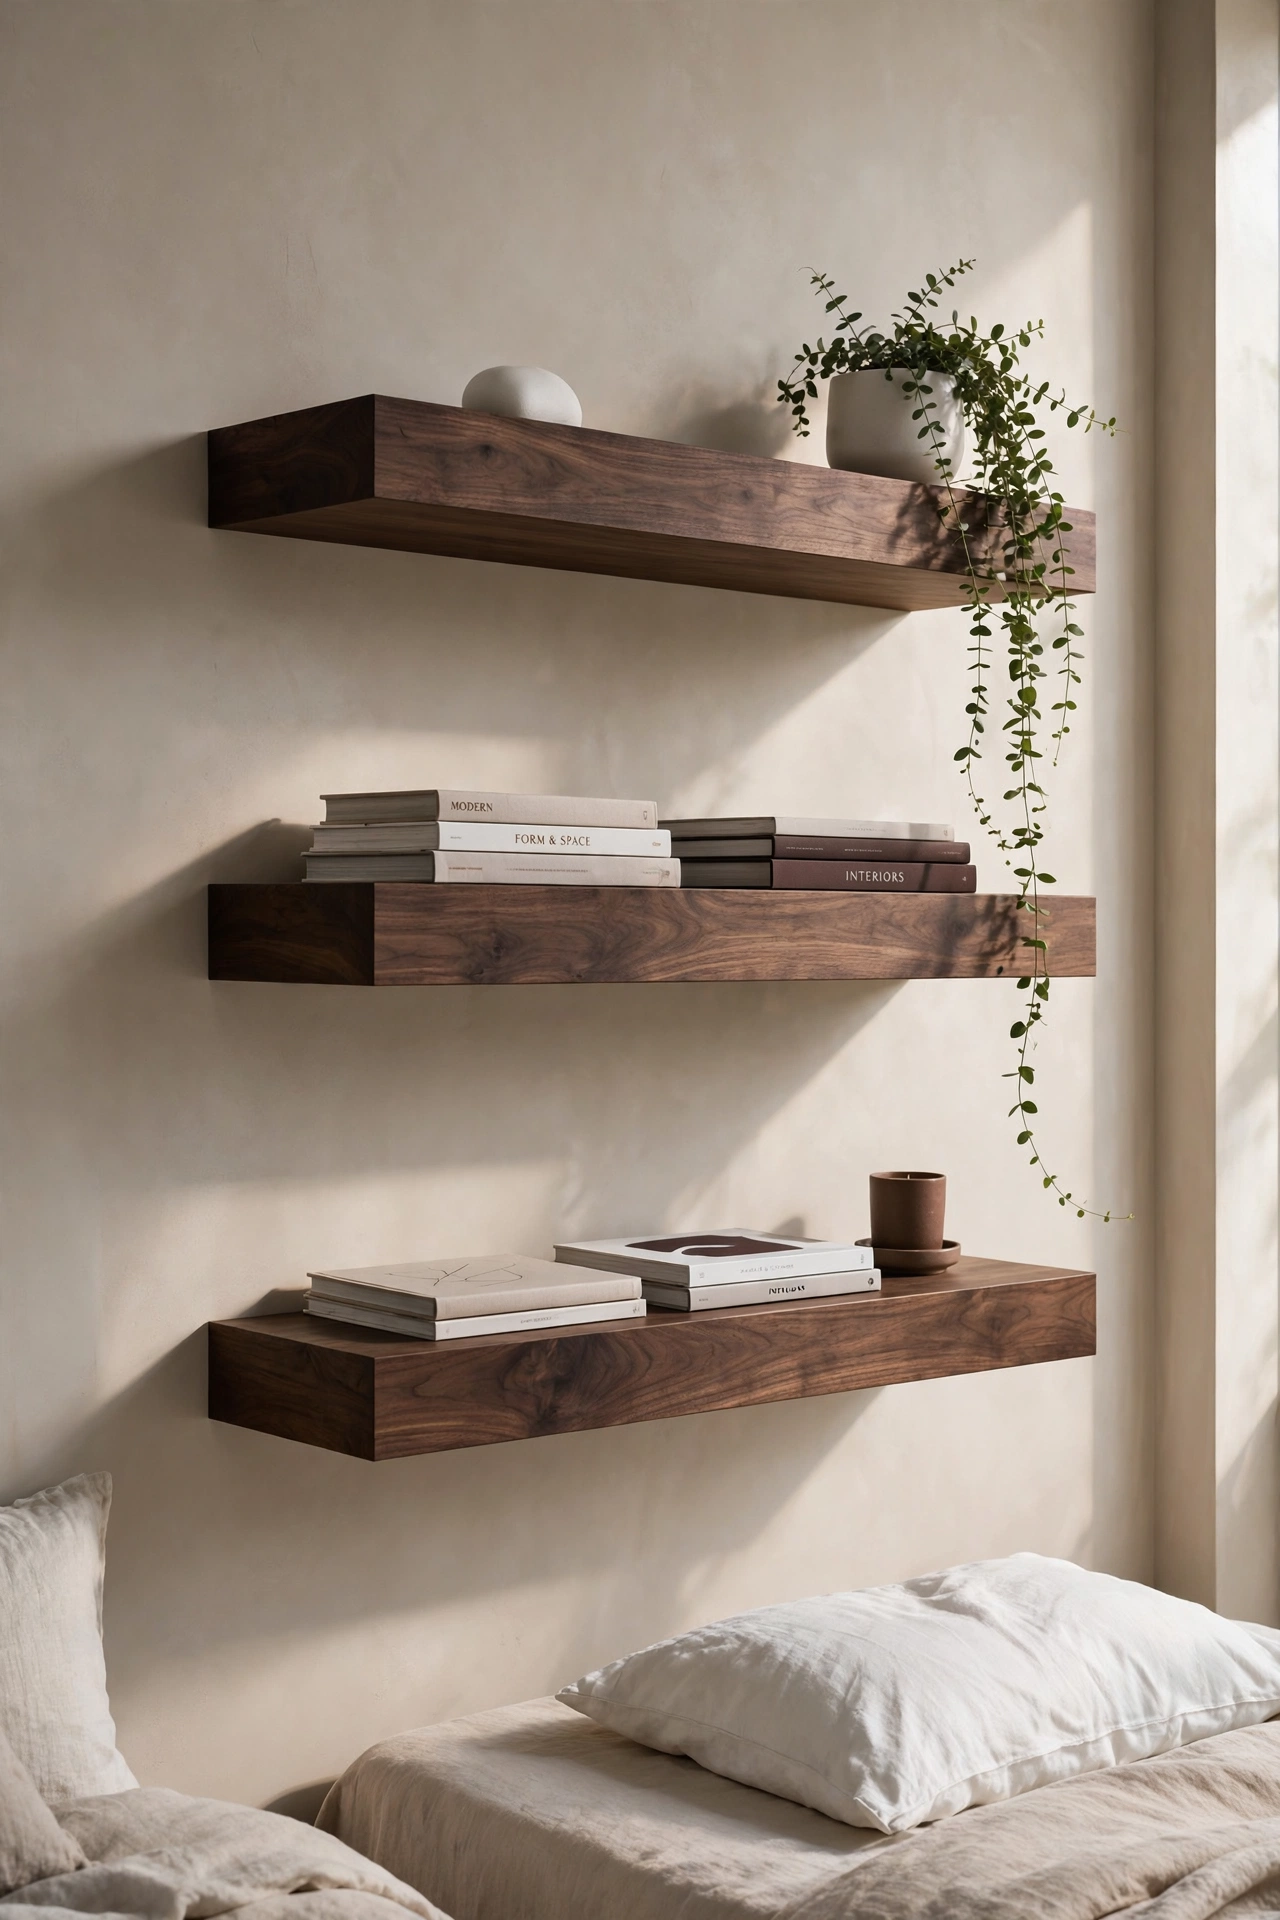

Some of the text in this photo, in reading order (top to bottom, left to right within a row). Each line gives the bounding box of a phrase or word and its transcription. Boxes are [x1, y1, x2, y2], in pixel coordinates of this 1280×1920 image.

[450, 801, 493, 812] MODERN
[515, 834, 591, 847] FORM & SPACE
[845, 870, 905, 883] INTERIORS
